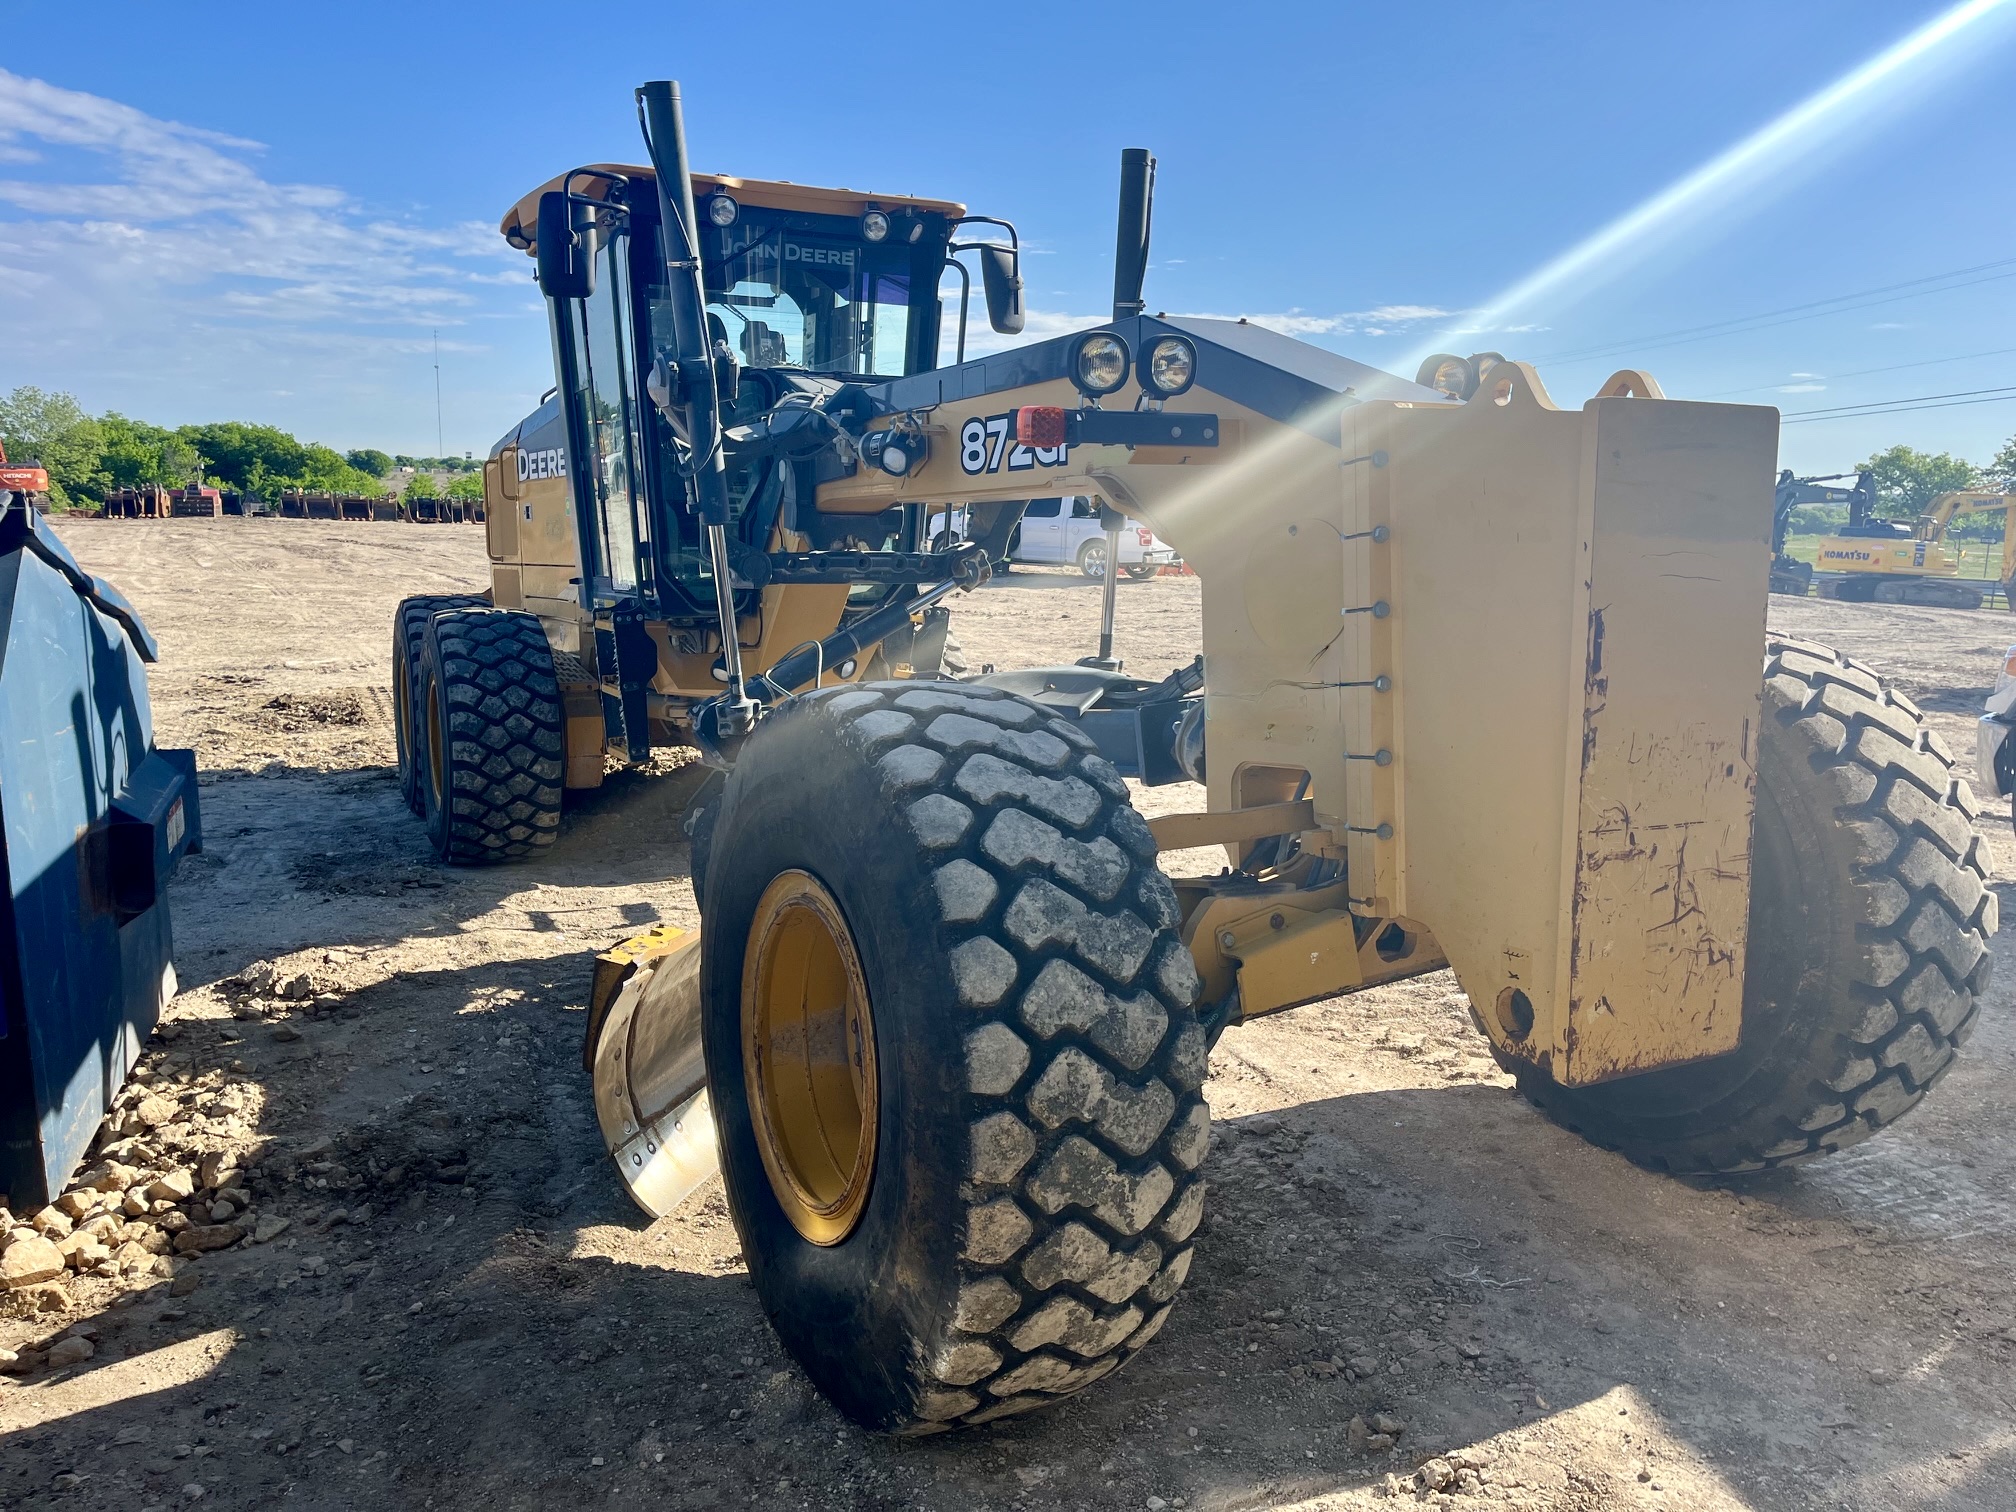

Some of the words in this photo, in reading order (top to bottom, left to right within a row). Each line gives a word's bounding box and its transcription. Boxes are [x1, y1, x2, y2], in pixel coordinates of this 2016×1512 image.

[785, 243, 855, 266] DEERE
[517, 447, 567, 482] DEERE
[1824, 550, 1871, 561] KOMATSU
